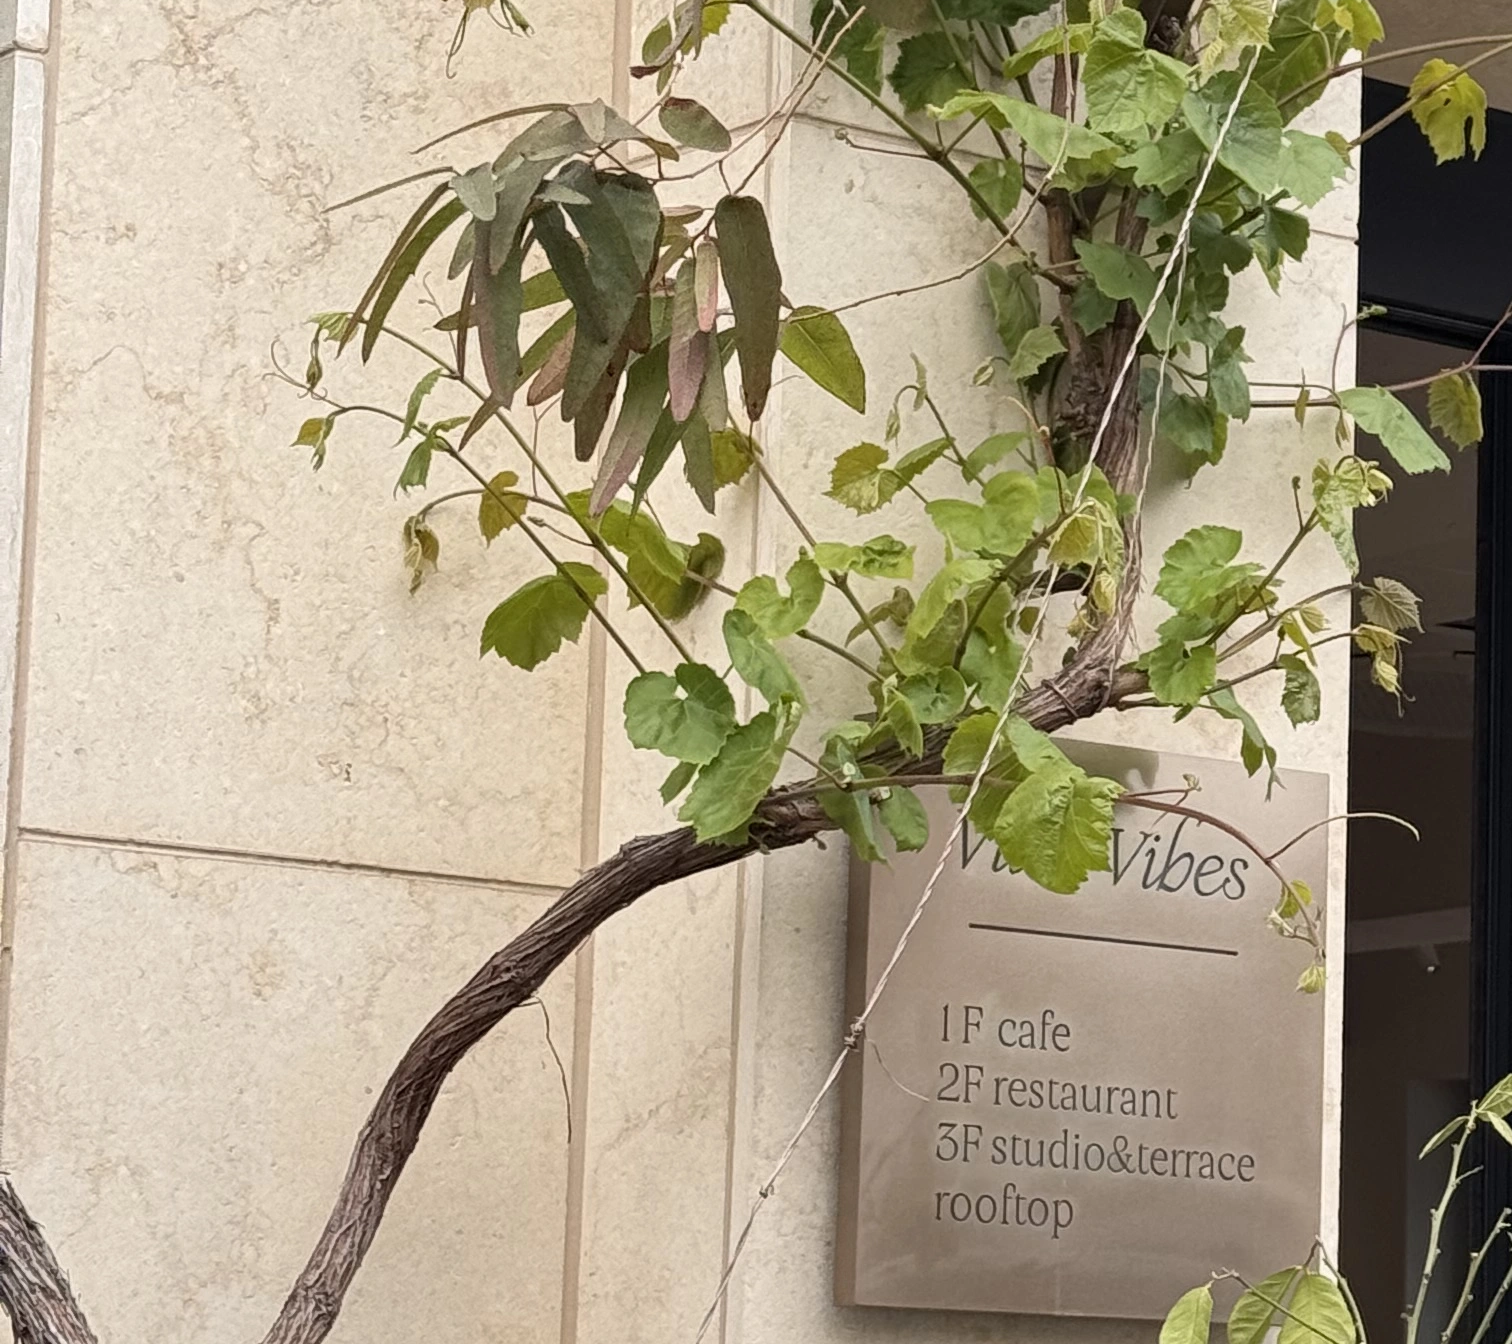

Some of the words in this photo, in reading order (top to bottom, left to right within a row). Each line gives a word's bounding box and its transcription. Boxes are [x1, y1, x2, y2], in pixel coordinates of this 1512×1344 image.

[1110, 815, 1249, 901] Vibes
[998, 1008, 1072, 1052] cafe
[937, 1062, 984, 1104] 2F
[993, 1072, 1179, 1120] restaurant
[935, 1122, 983, 1163] 3F
[991, 1129, 1256, 1184] studio&terrace
[934, 1183, 1074, 1239] rooftop
